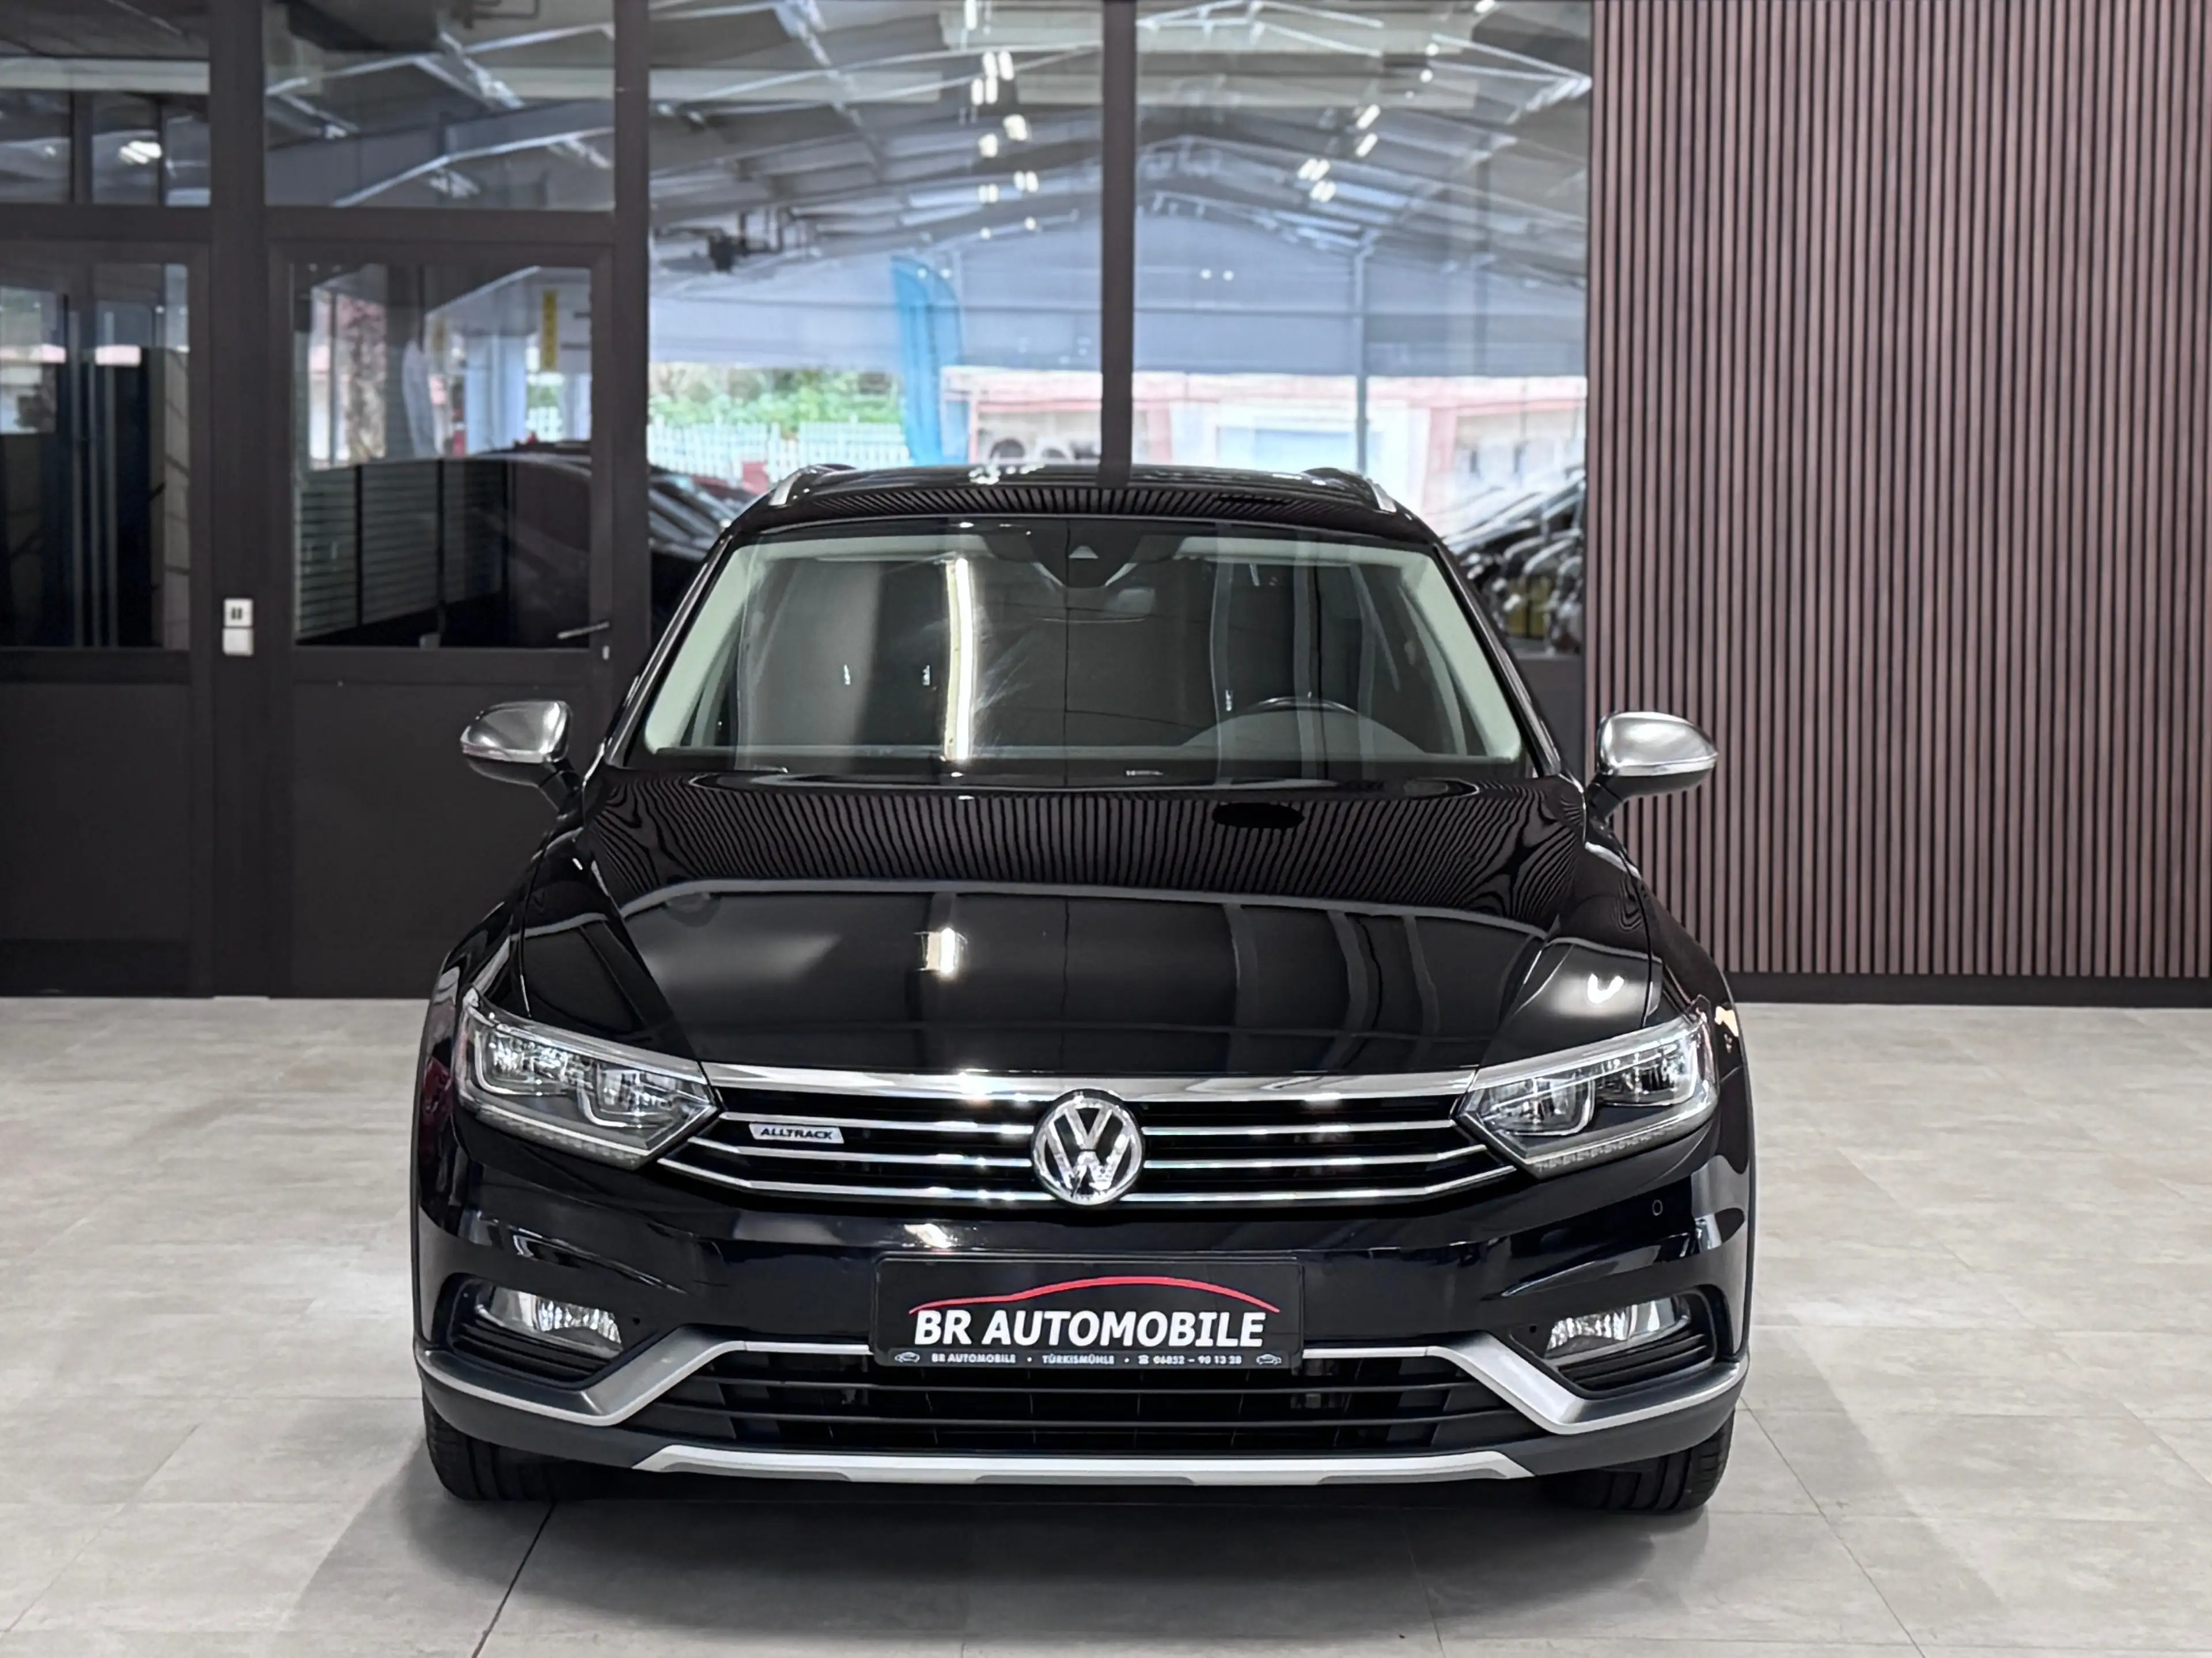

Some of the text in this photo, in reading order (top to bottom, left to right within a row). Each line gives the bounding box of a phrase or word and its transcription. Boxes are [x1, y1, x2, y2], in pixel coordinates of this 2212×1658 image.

[760, 1128, 834, 1140] ALLTRACK
[1040, 1100, 1135, 1200] VW
[914, 1310, 1267, 1347] BR AUTOMOBILE
[931, 1353, 946, 1363] BR
[947, 1353, 1016, 1364] AUTOMOBILE
[1041, 1353, 1115, 1365] TÜRKISMÜHLE
